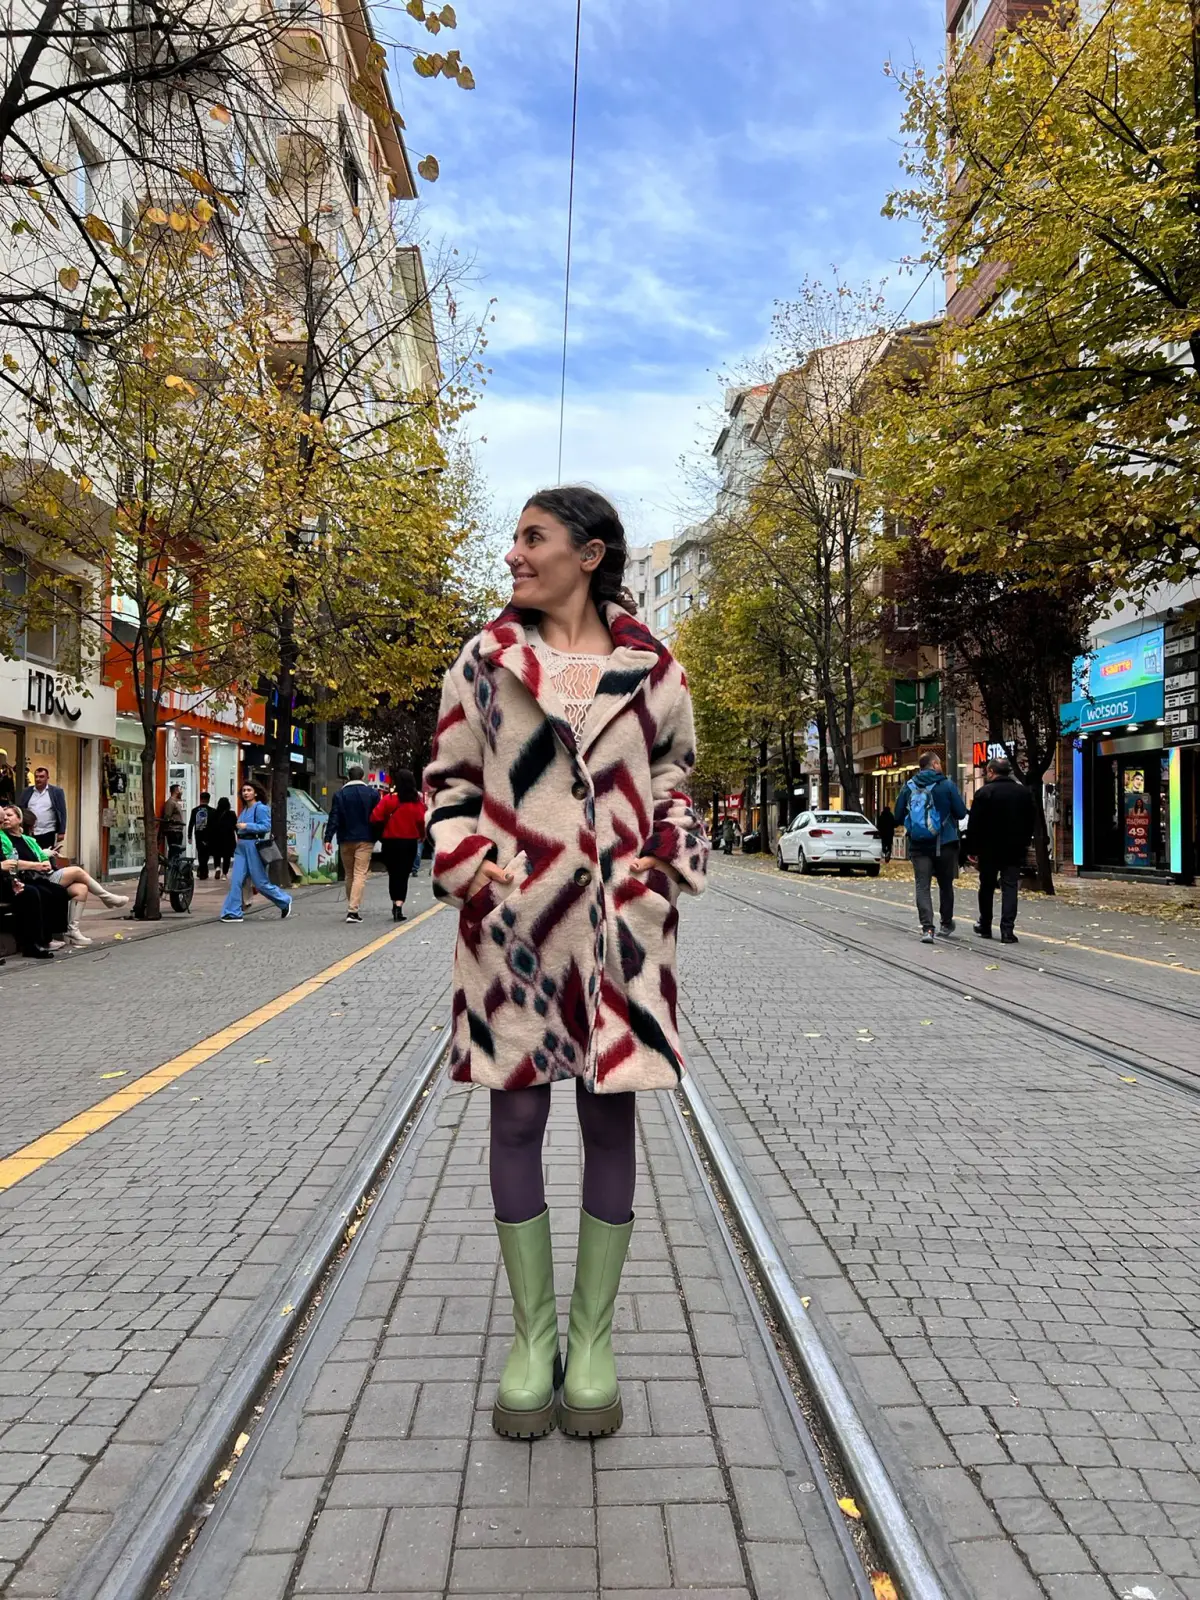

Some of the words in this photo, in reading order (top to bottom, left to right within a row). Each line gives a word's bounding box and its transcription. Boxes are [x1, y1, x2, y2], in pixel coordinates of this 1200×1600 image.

[27, 669, 55, 715] LTB
[1087, 701, 1129, 720] watsons
[973, 742, 986, 765] IN
[987, 741, 1015, 760] STRET
